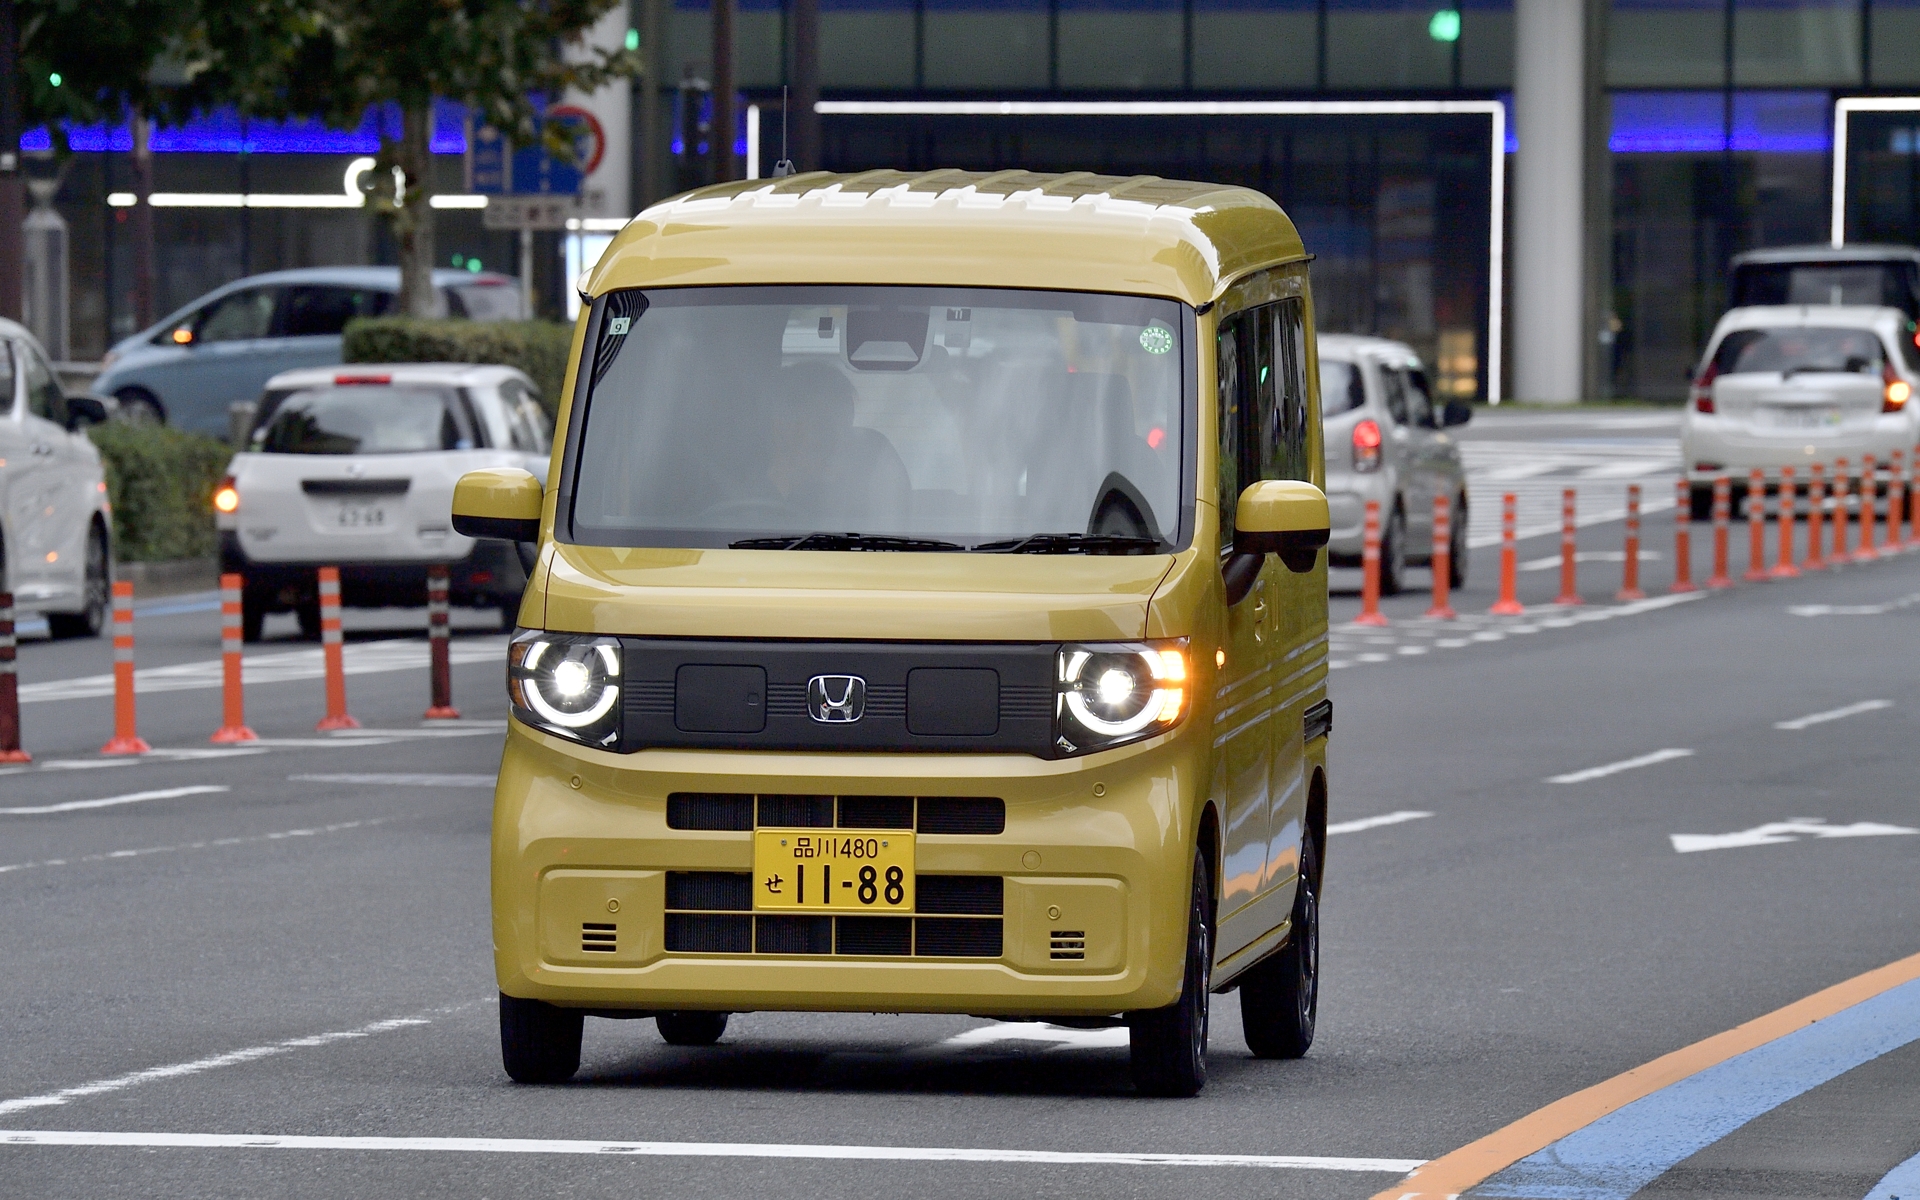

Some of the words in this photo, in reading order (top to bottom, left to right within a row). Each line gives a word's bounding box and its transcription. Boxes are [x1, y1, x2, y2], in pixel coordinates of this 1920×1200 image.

[615, 324, 622, 333] 9
[1153, 337, 1160, 345] 7
[764, 873, 784, 894] せ
[796, 864, 904, 905] 11-88
